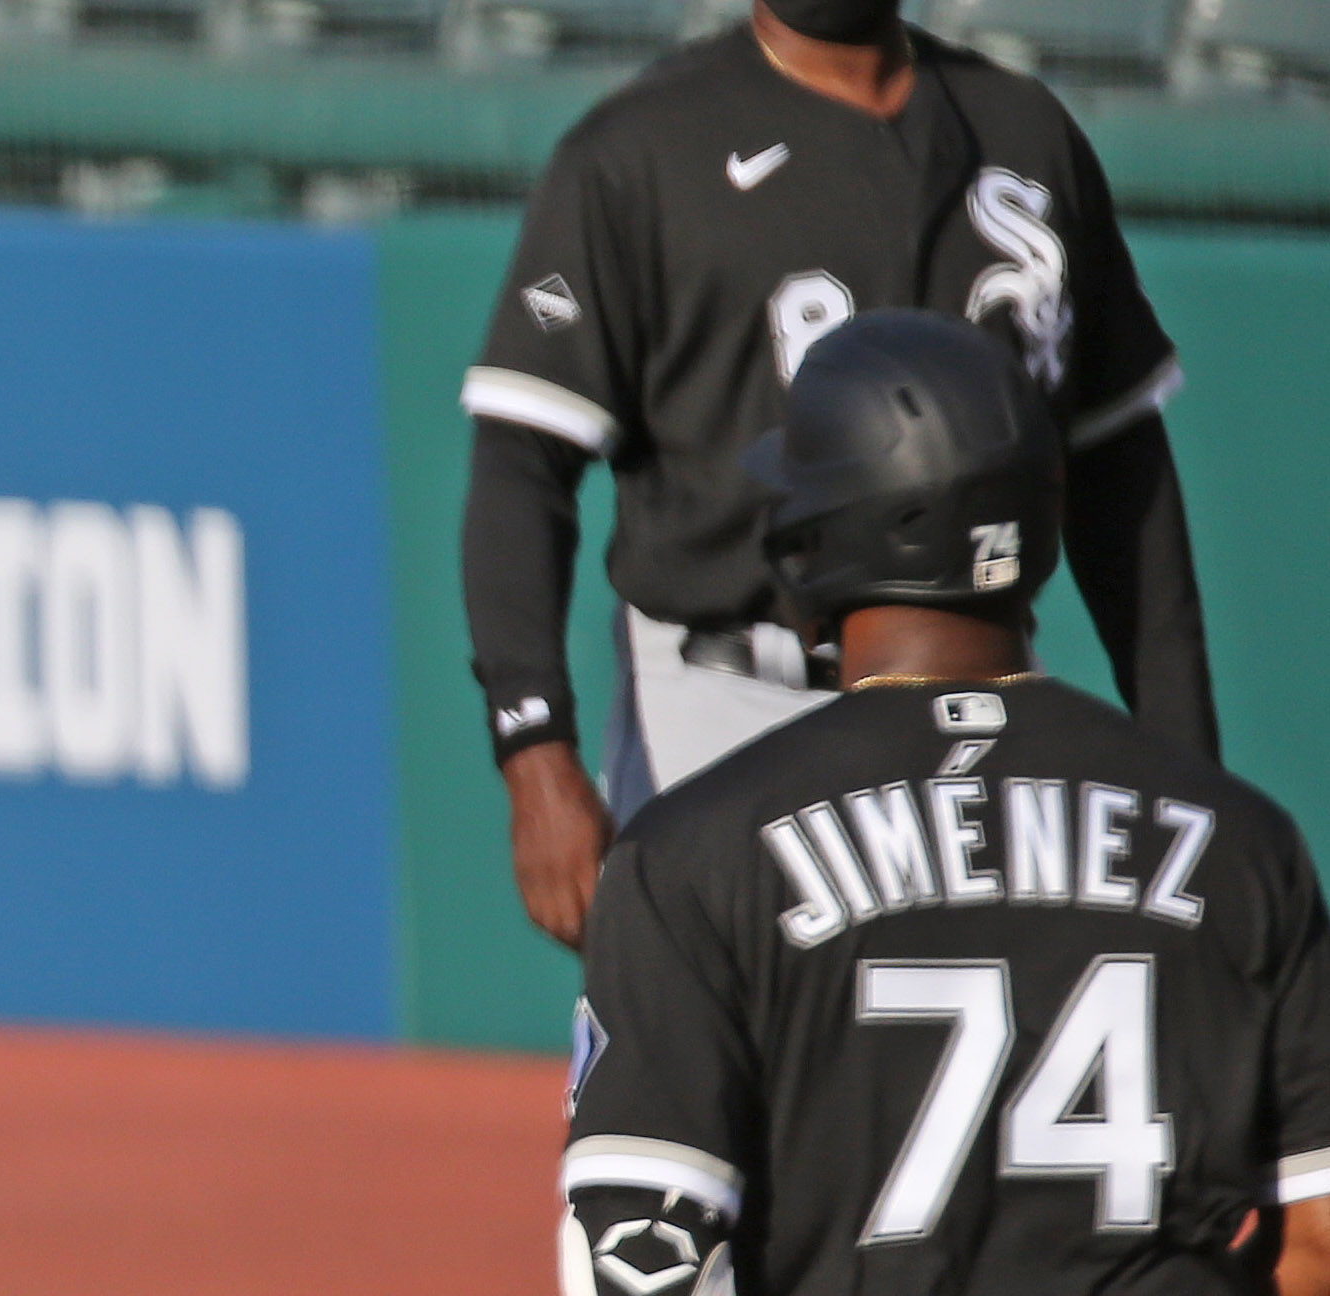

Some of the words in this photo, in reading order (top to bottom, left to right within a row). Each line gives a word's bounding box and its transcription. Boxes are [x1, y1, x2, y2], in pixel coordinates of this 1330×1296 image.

[969, 521, 1020, 562] 74
[762, 739, 1216, 949] JIMÉNEZ
[855, 953, 1175, 1248] 74
